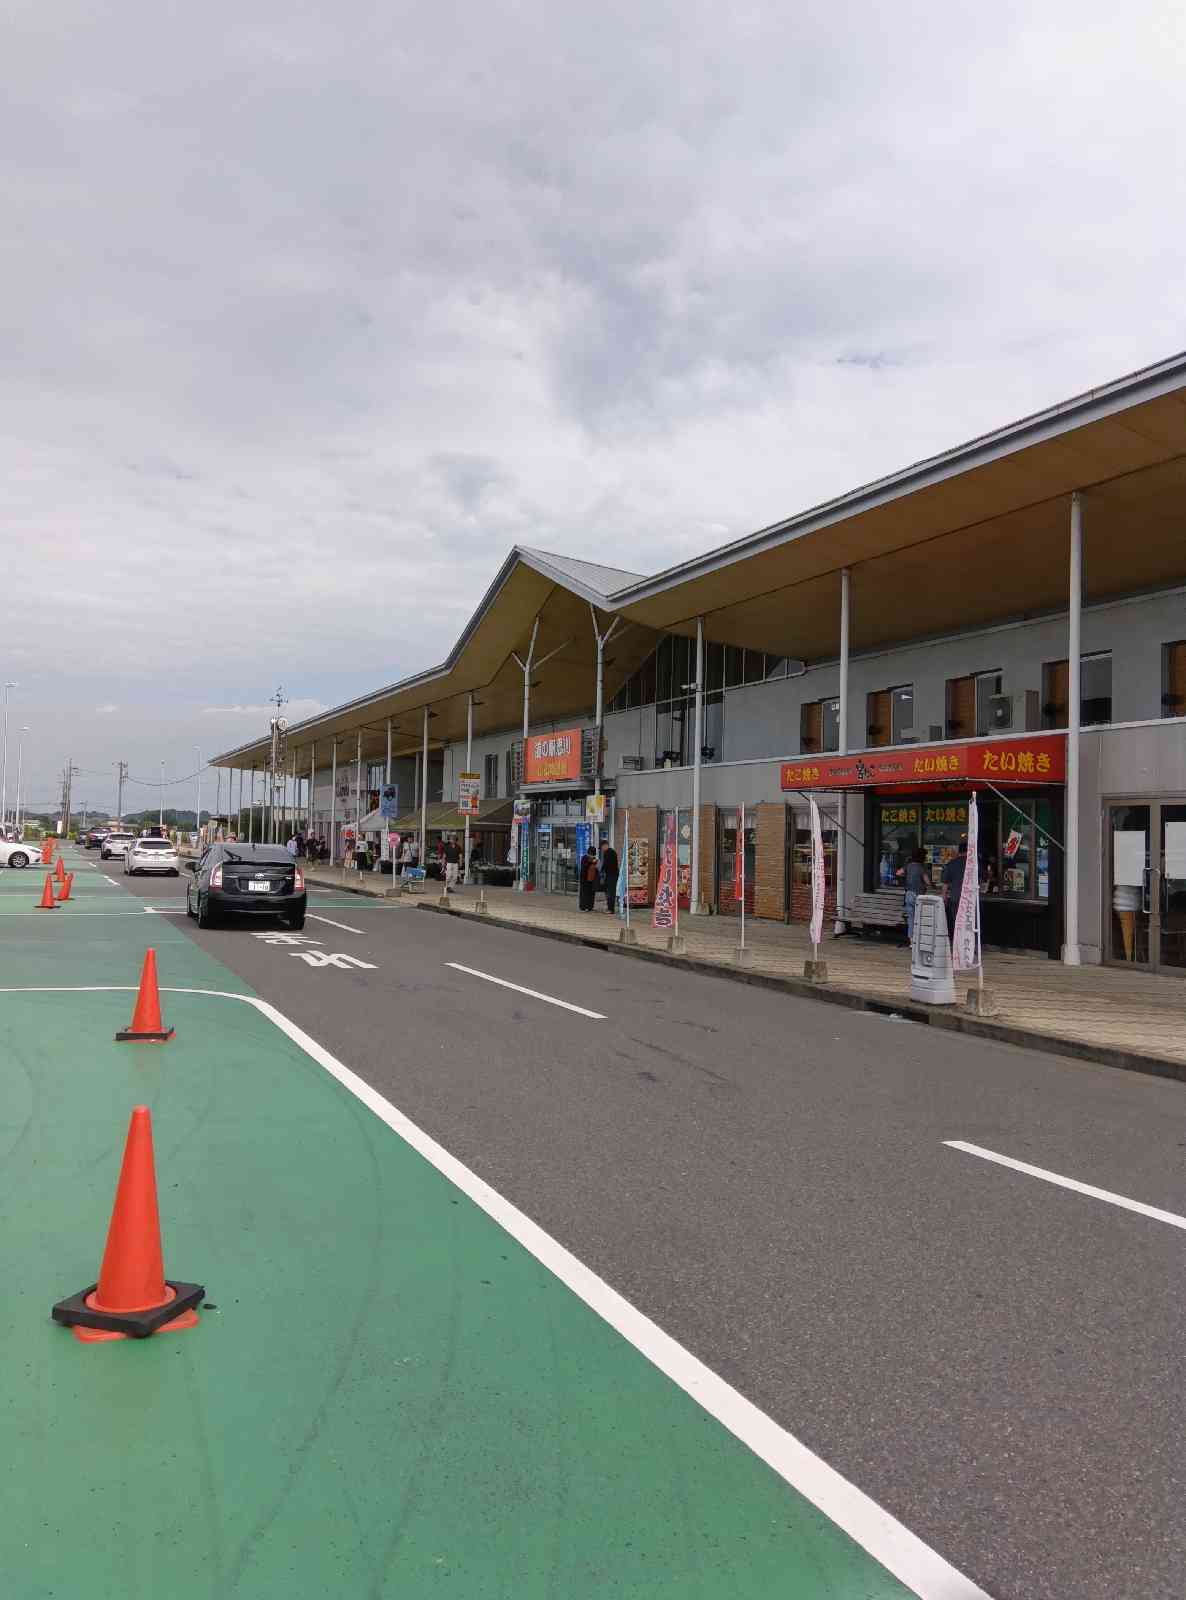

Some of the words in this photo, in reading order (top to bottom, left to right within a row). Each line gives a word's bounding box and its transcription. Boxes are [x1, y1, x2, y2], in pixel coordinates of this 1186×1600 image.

[912, 754, 960, 773] たい焼き
[983, 750, 1051, 773] たい焼き
[784, 767, 820, 784] たこ焼き
[926, 808, 967, 823] たい焼き
